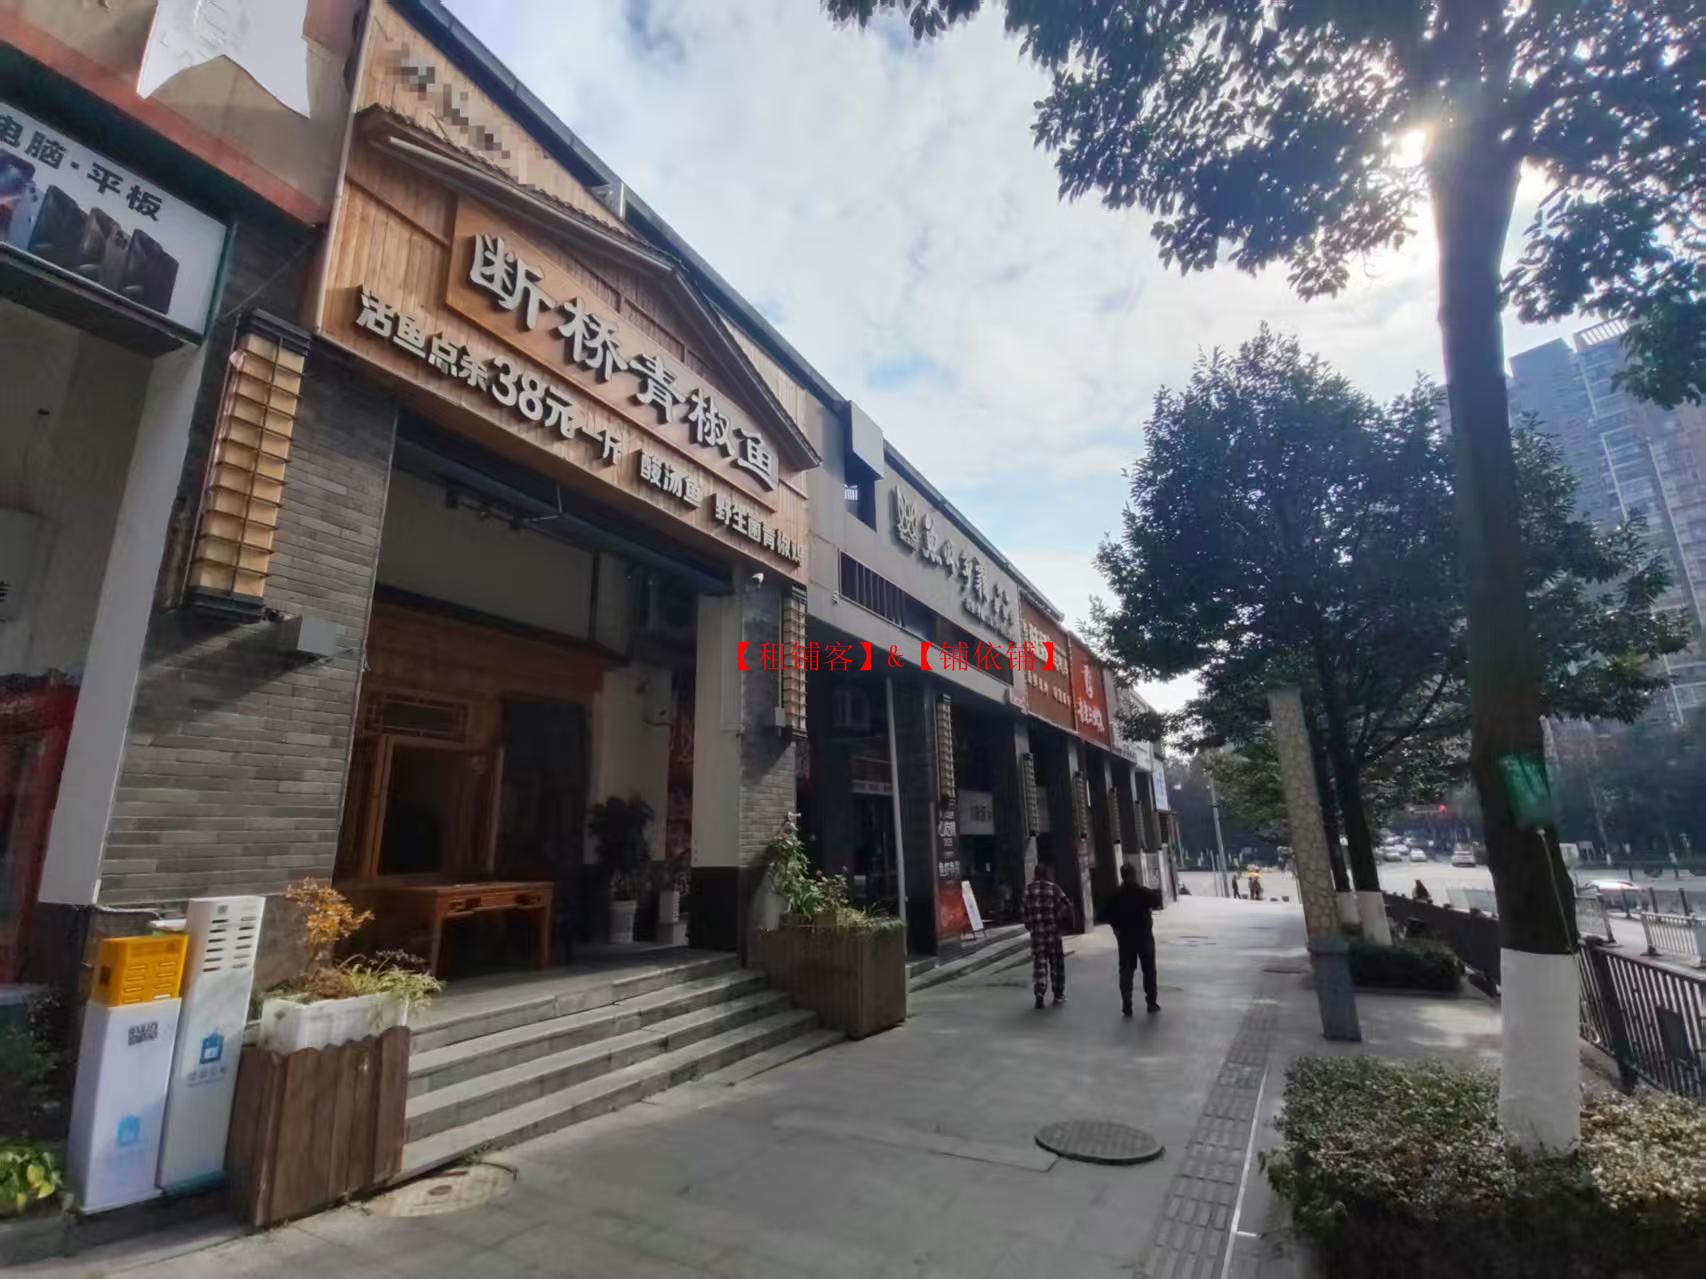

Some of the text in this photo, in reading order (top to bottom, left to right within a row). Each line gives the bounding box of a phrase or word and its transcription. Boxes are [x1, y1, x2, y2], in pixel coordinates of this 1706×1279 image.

[470, 233, 779, 490] 断桥青椒鱼
[641, 452, 701, 508] 酸汤鱼
